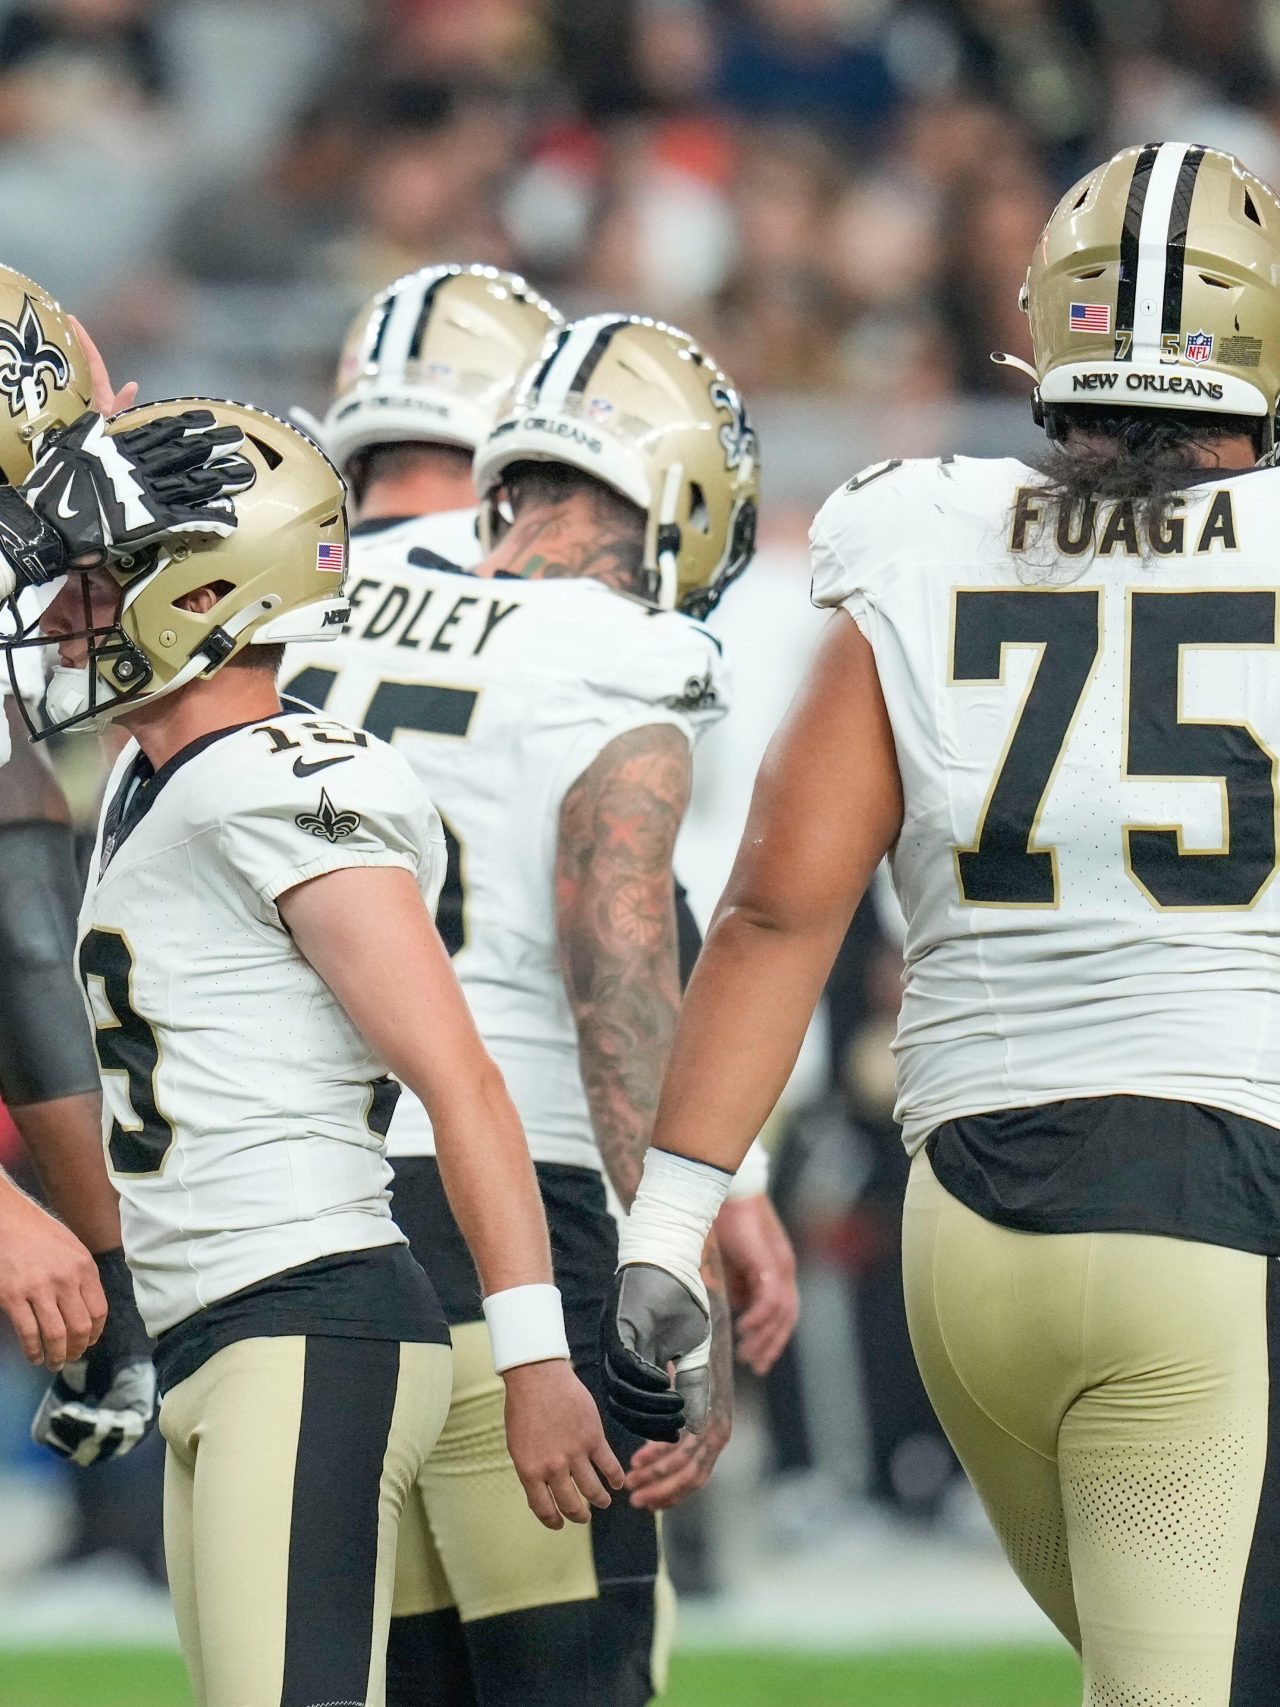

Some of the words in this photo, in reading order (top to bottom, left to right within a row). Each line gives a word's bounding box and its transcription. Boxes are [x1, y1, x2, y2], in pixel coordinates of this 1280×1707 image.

[1072, 373, 1119, 392] NEW
[1126, 373, 1224, 400] ORLEANS
[1188, 345, 1209, 359] NFL
[1006, 486, 1241, 558] FUAGA
[341, 577, 521, 657] EDLEY
[946, 585, 1280, 912] 75
